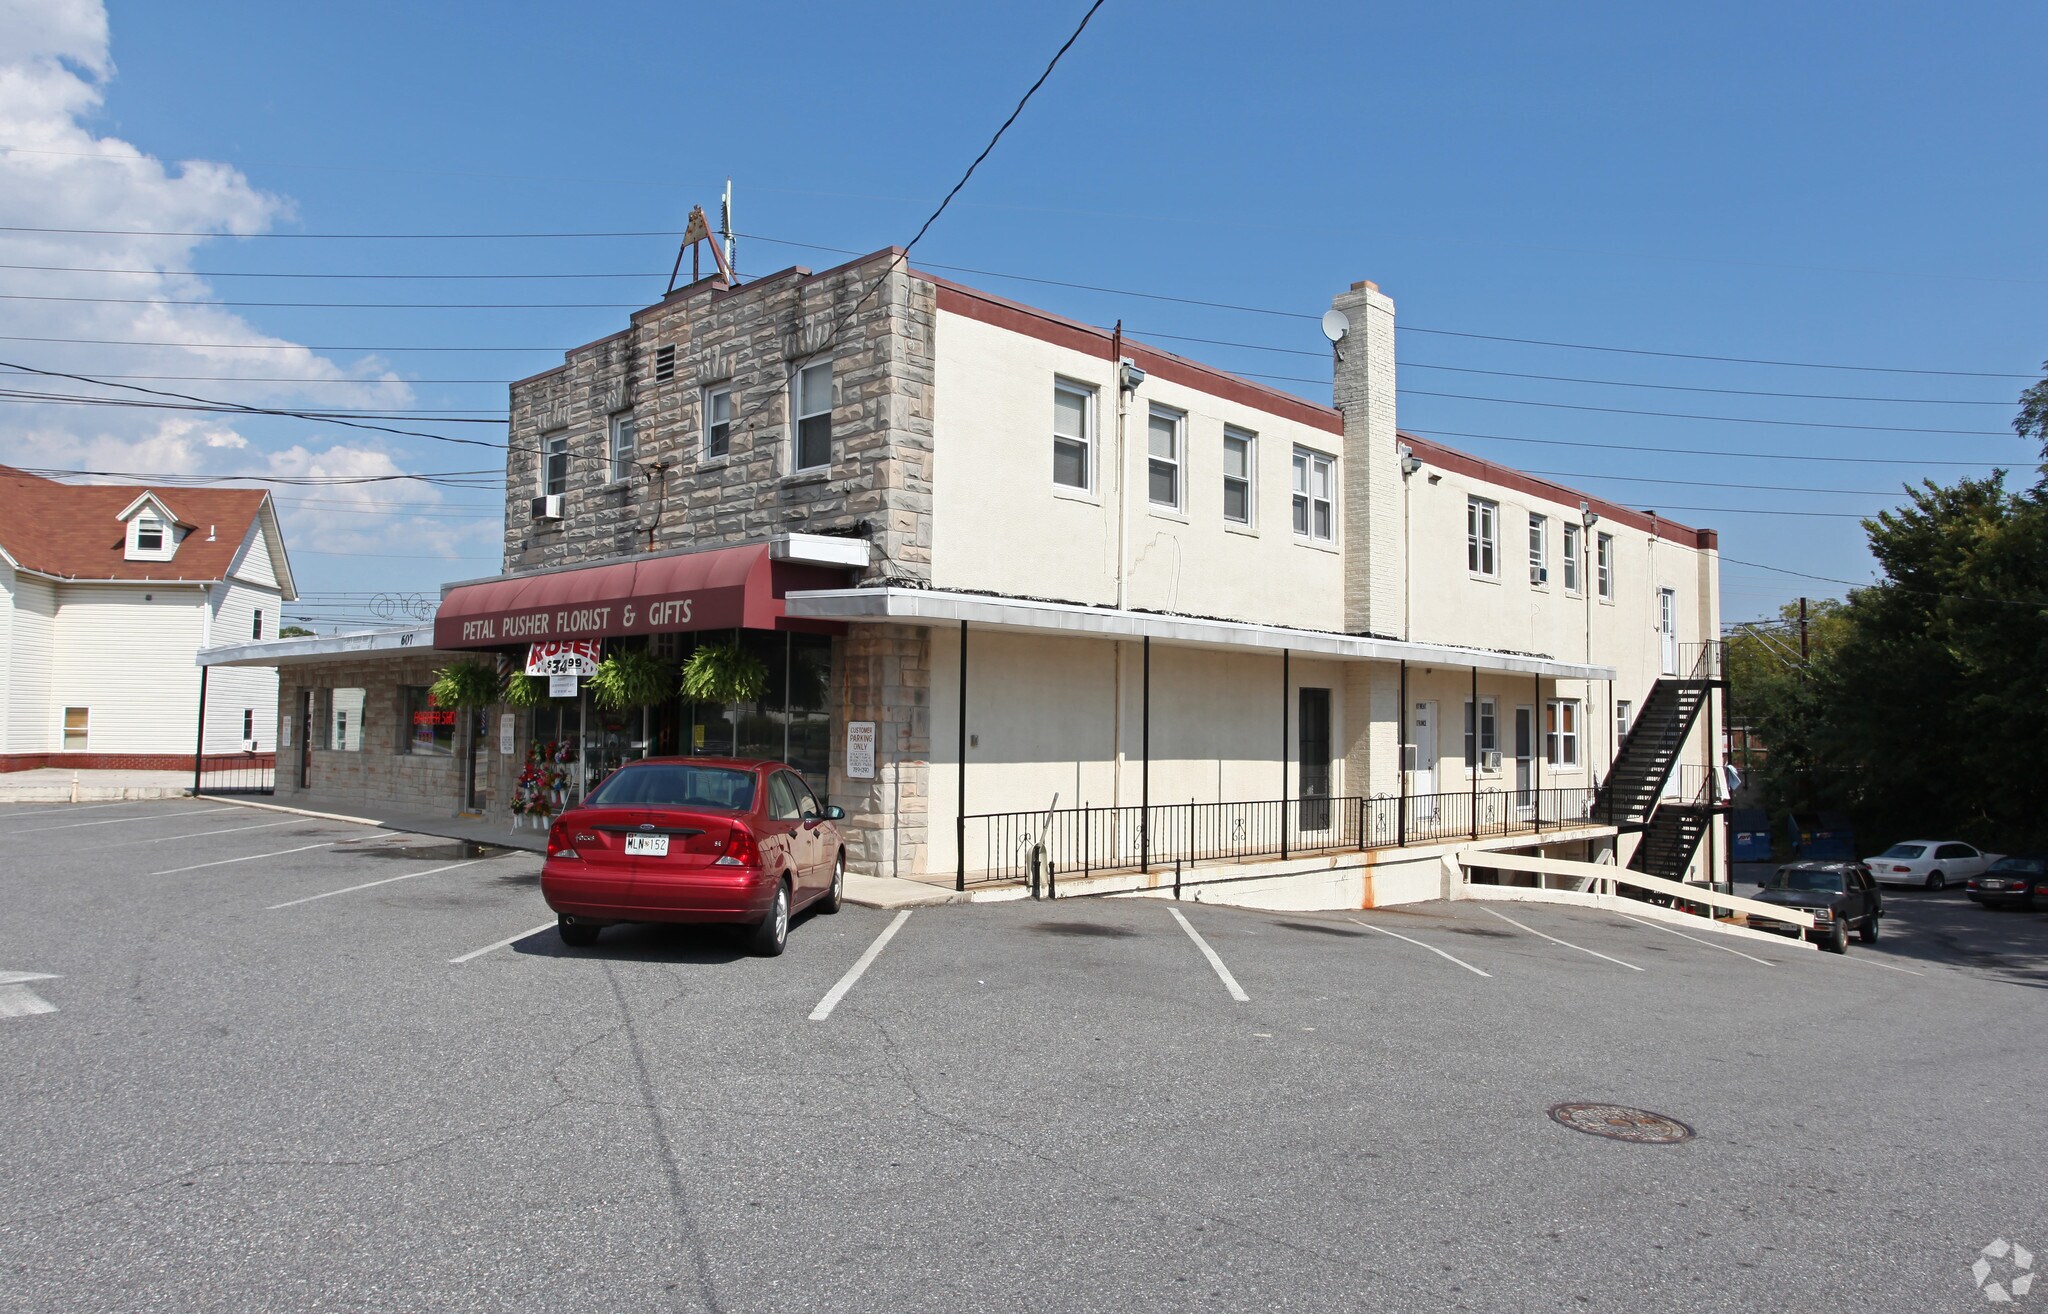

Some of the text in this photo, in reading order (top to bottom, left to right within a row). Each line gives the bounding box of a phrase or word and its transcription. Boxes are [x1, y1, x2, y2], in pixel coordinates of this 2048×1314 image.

[463, 599, 692, 640] PETAL PUSHER FLORIST & GIFTS
[401, 634, 413, 645] 607
[529, 639, 600, 666] ROSES
[850, 726, 872, 734] CUSTOMER
[850, 734, 873, 742] PARKING
[627, 838, 666, 850] MLN 152
